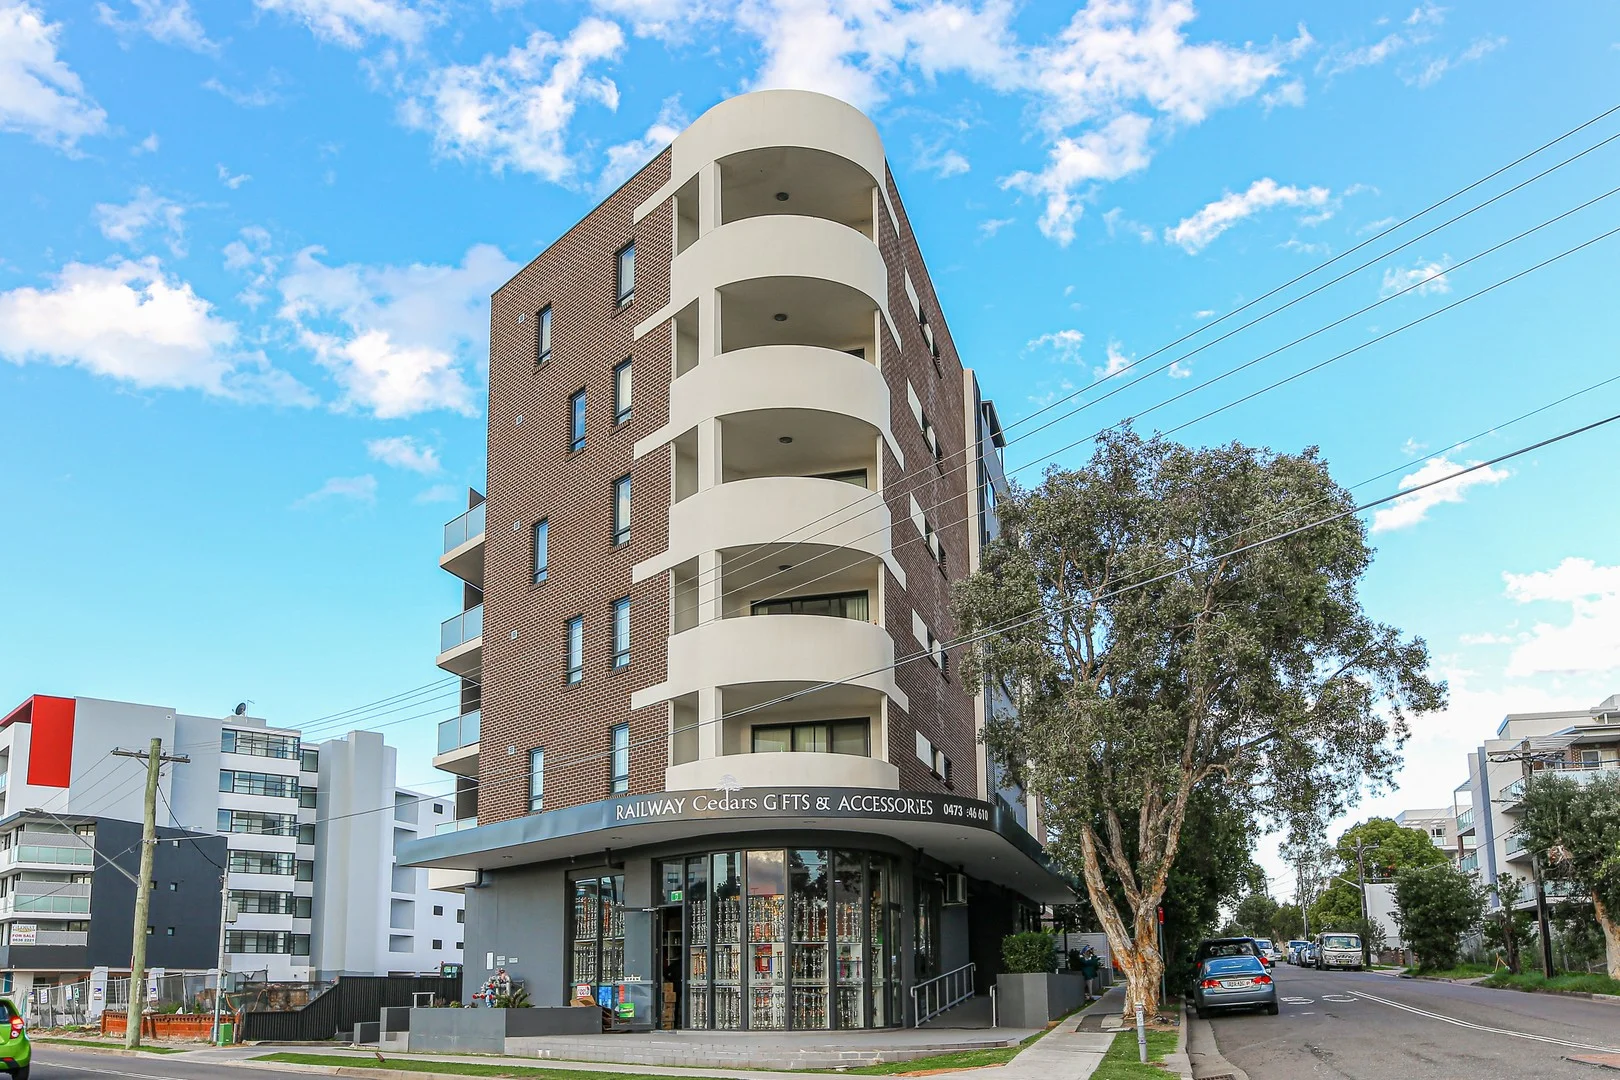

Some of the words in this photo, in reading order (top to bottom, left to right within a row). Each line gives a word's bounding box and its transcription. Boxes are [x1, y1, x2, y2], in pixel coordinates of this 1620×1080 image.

[616, 797, 686, 820] RAILWAY
[692, 788, 758, 811] Cedars
[815, 796, 831, 811] &
[837, 795, 934, 815] ACCESSORIES
[943, 803, 964, 817] 0473
[977, 808, 989, 821] 610
